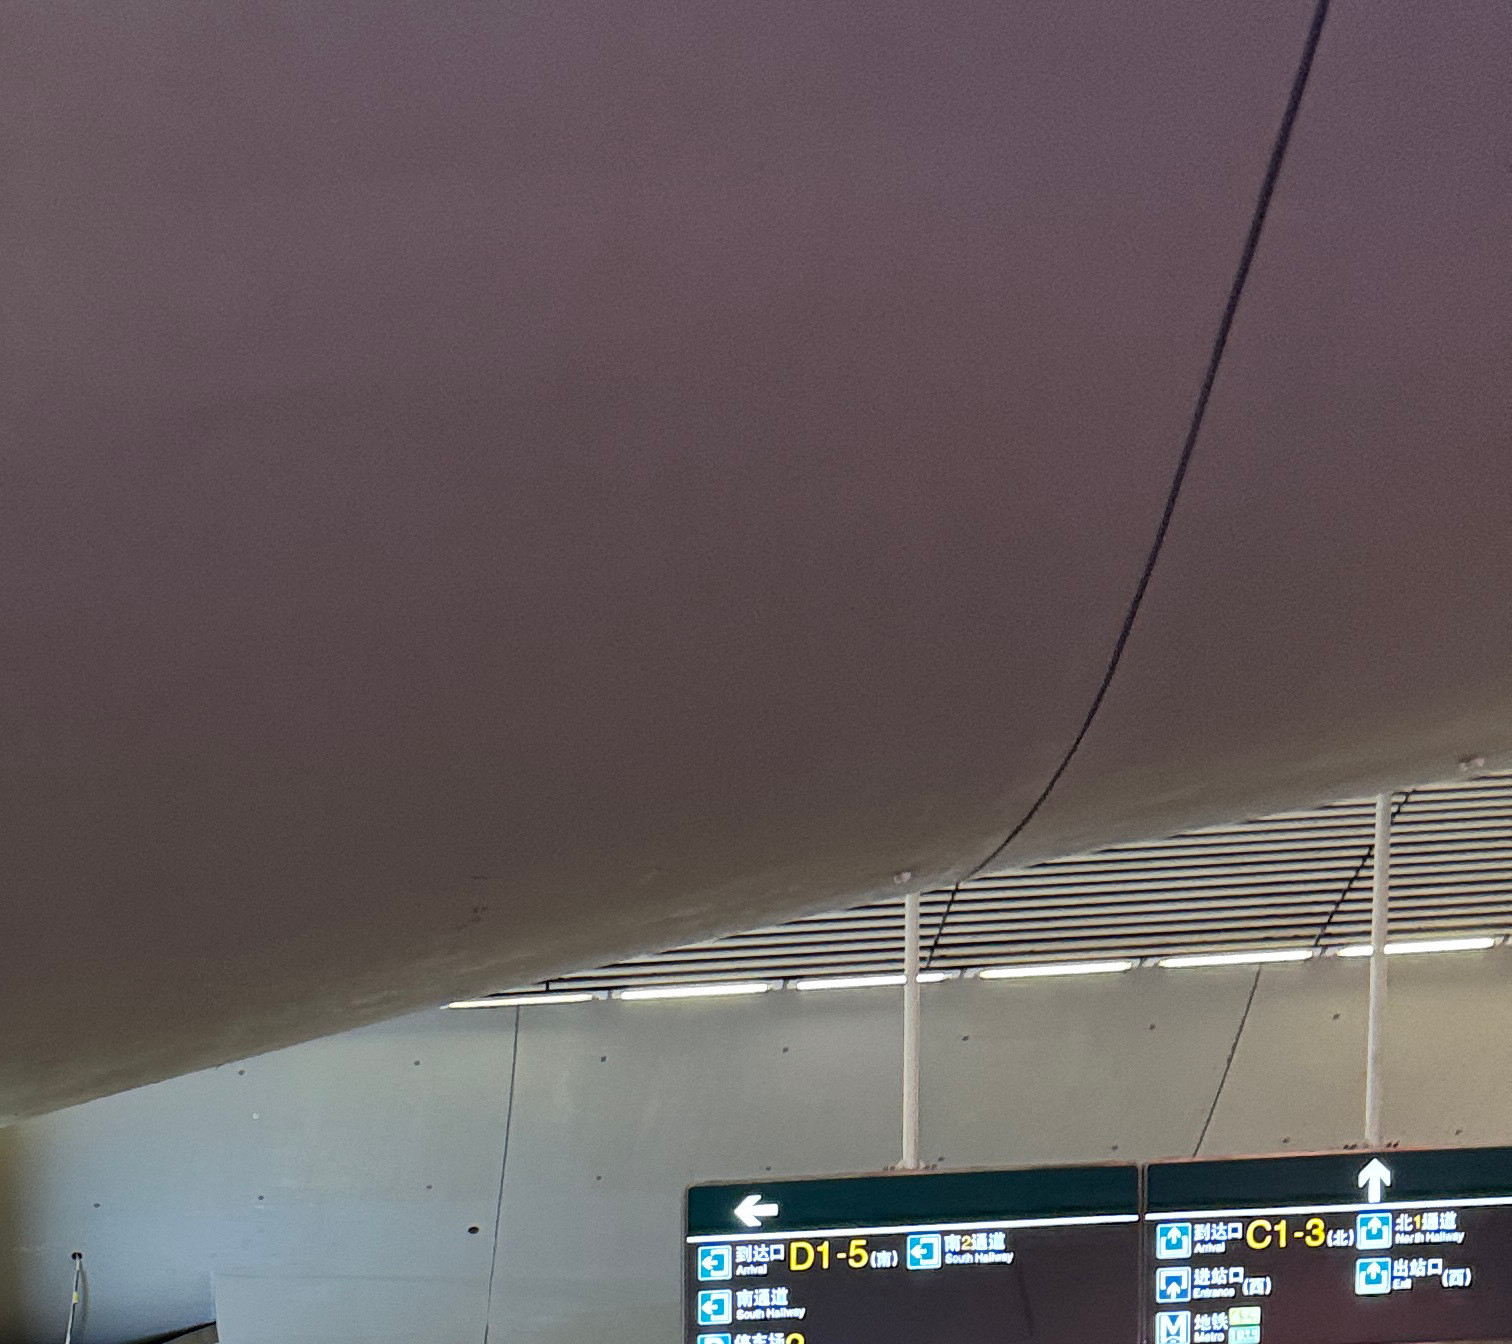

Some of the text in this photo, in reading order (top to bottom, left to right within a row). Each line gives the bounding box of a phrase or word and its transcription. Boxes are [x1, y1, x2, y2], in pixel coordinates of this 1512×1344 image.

[1194, 1217, 1354, 1249] 到达口 C1-3 (北)
[735, 1244, 785, 1263] 到达口
[790, 1239, 869, 1271] D1-5
[1194, 1242, 1226, 1254] Arrival
[945, 1252, 974, 1264] South
[1393, 1258, 1443, 1277] 出站口
[735, 1264, 768, 1276] Arrival
[1194, 1266, 1244, 1285] 进站口
[736, 1287, 788, 1308] 南通道
[736, 1309, 765, 1320] South
[1194, 1312, 1228, 1331] 地铁
